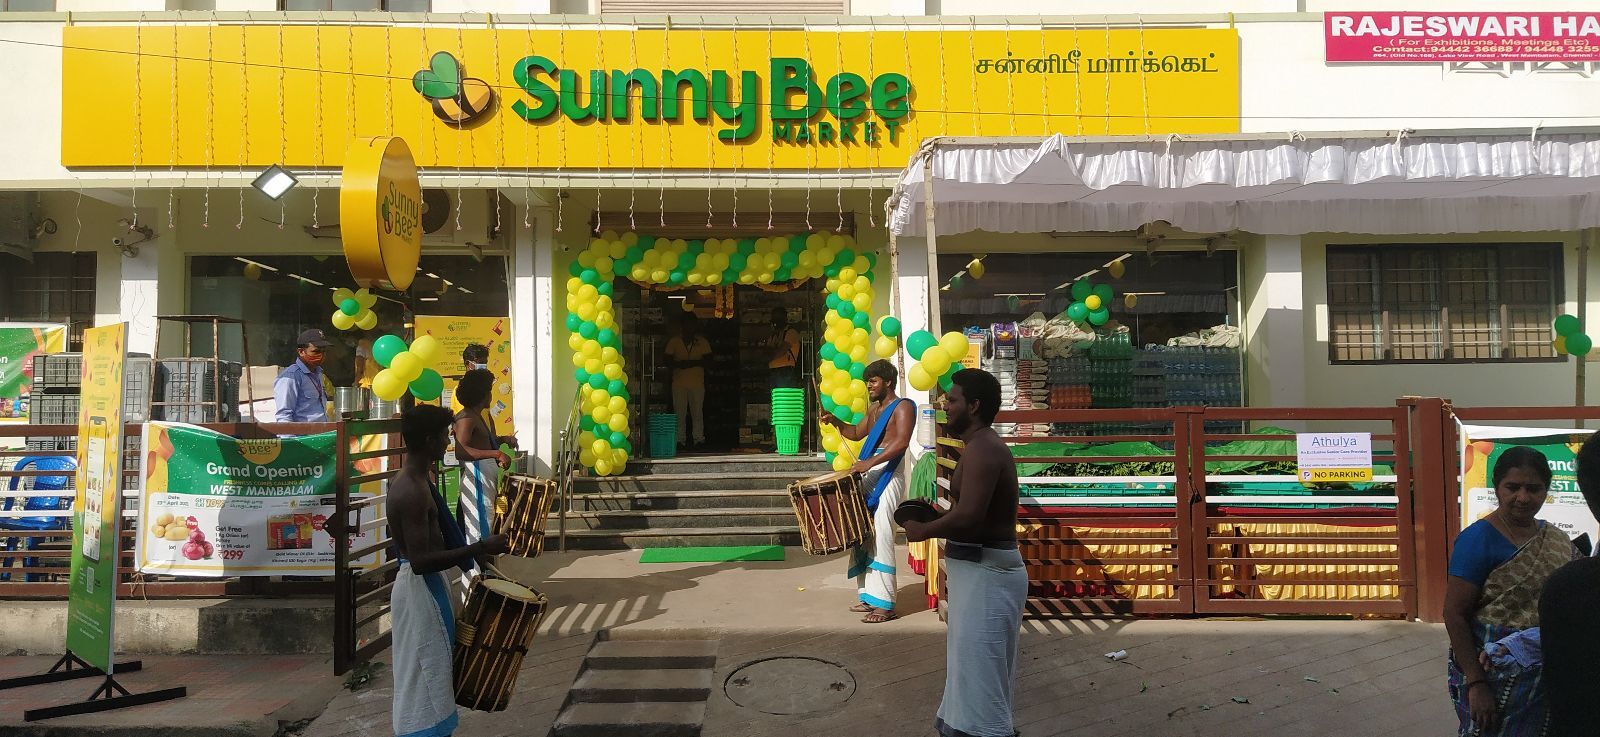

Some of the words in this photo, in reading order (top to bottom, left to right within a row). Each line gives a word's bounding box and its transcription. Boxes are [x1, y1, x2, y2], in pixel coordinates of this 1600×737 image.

[1331, 16, 1540, 37] RAJESWARI
[1501, 38, 1560, 47] Meetings
[511, 55, 758, 140] Sunny
[770, 57, 912, 120] Bee
[773, 121, 902, 145] MARKET
[389, 181, 419, 227] Sunny
[394, 211, 412, 236] Bee
[1312, 436, 1357, 447] Athulya
[249, 445, 271, 455] Bee
[206, 462, 250, 477] Grand
[255, 464, 324, 480] Opening
[1314, 471, 1328, 479] NO
[210, 485, 243, 496] WEST
[246, 485, 314, 496] MAMBALAM
[1549, 480, 1570, 491] EST
